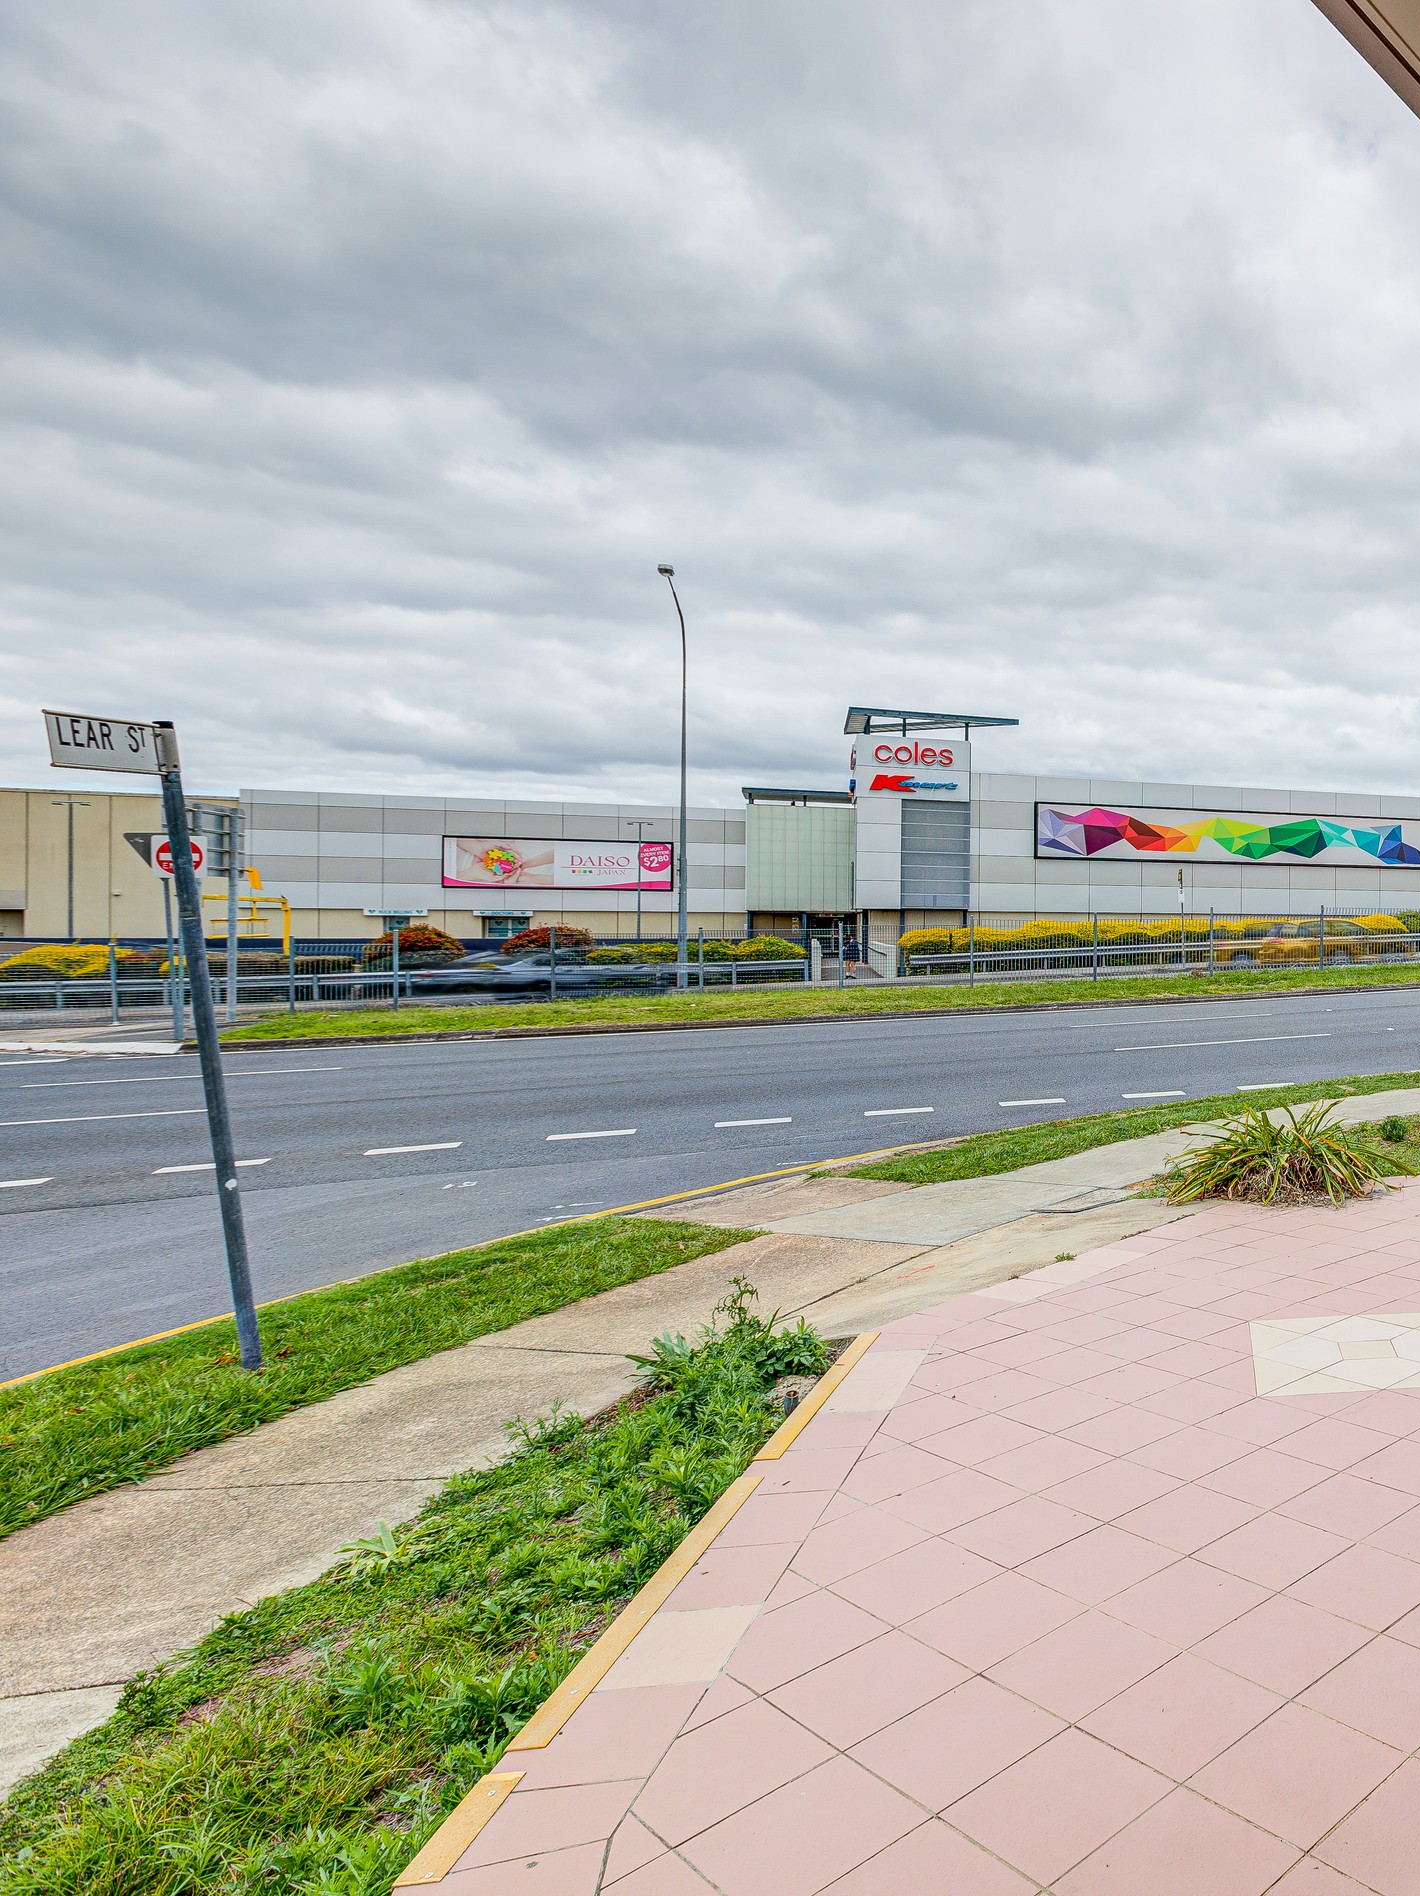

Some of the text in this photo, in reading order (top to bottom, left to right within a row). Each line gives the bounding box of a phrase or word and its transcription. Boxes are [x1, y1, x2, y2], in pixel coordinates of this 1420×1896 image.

[55, 716, 146, 753] LEAR ST
[873, 741, 954, 767] coles
[870, 774, 958, 793] Kmart
[570, 855, 630, 867] DAISO
